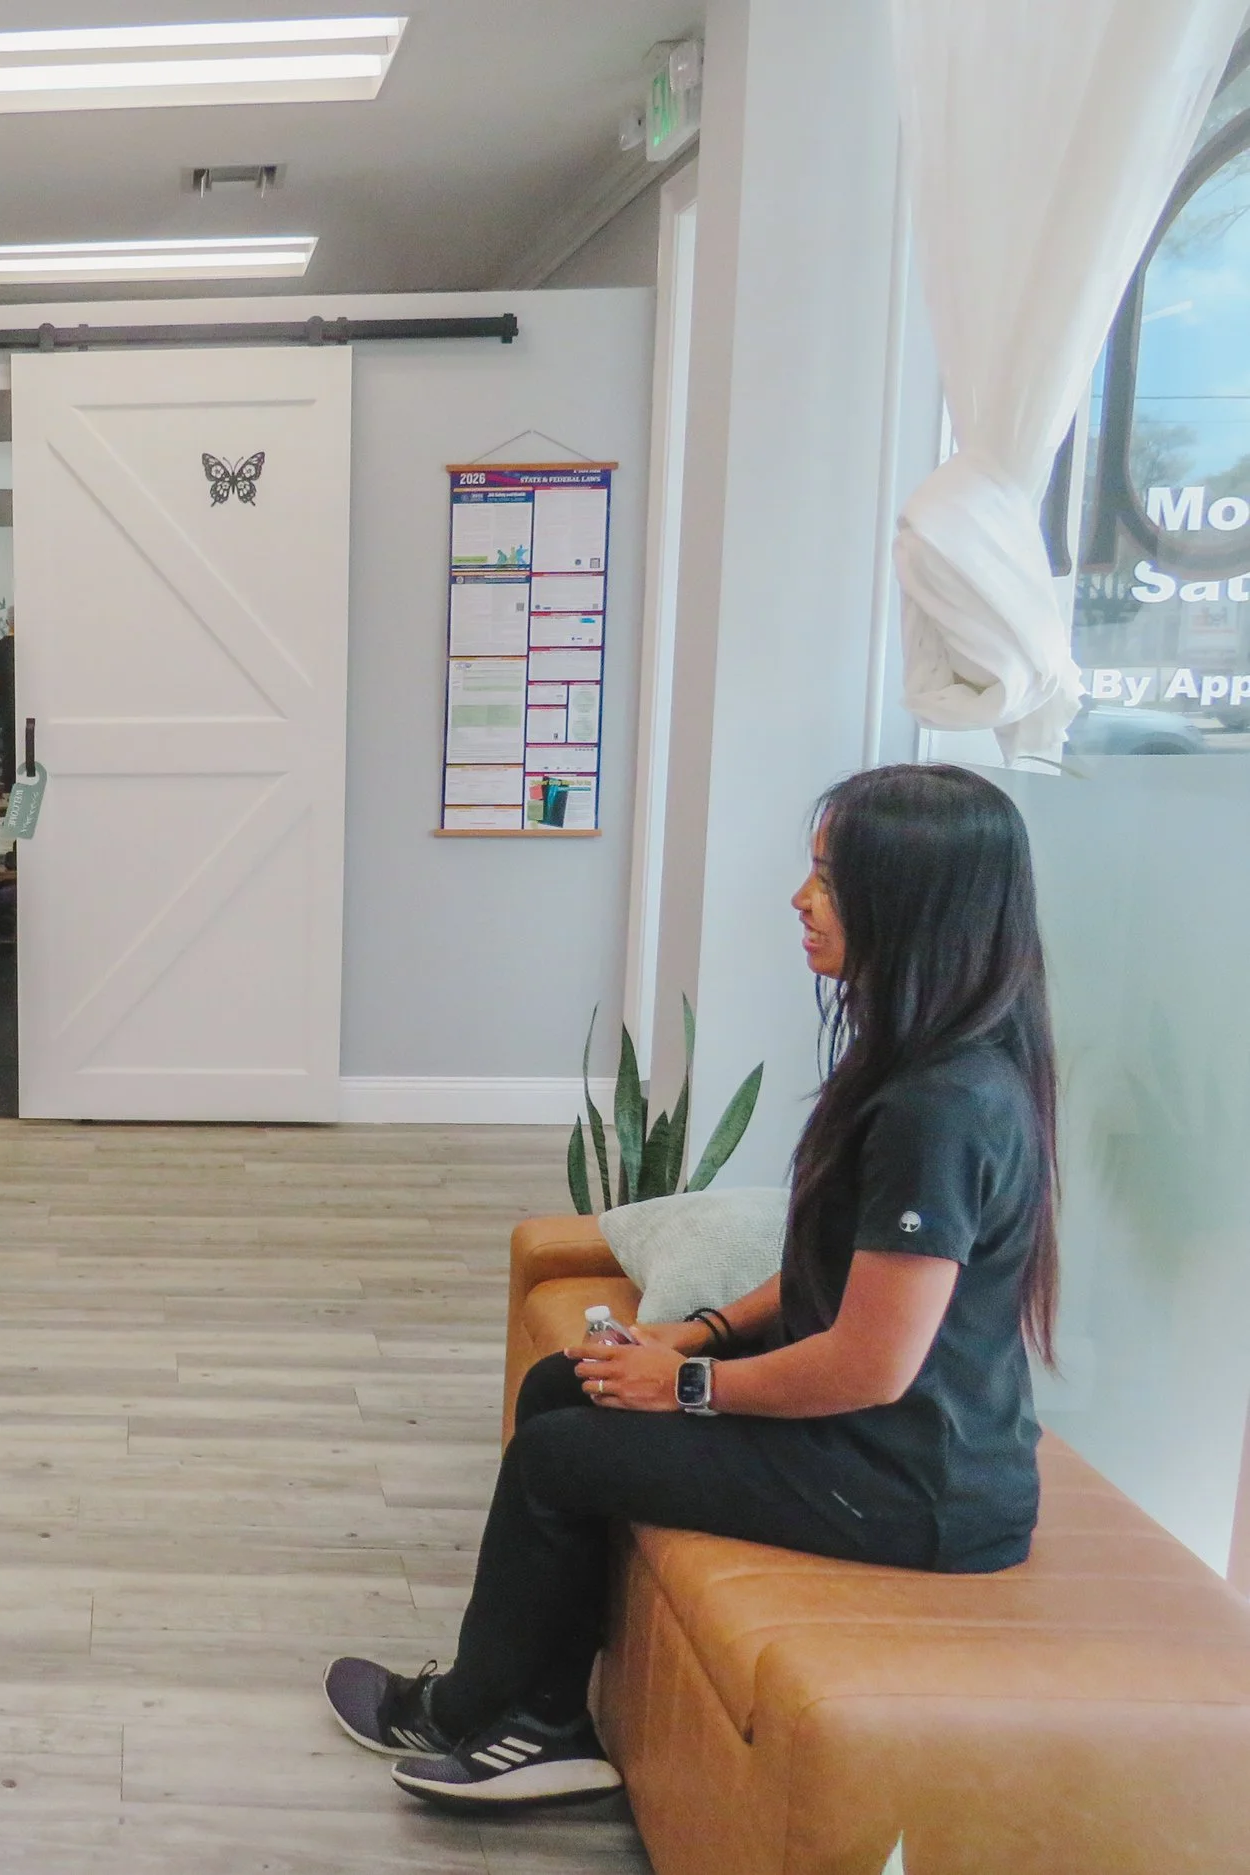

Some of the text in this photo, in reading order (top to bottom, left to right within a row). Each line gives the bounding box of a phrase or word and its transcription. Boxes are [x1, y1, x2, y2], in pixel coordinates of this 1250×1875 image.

[459, 473, 486, 485] 2026
[581, 475, 601, 483] LAWS
[1145, 486, 1250, 531] Mo
[1132, 560, 1250, 602] Sat
[1091, 668, 1250, 706] By App
[8, 789, 24, 828] WELCOME
